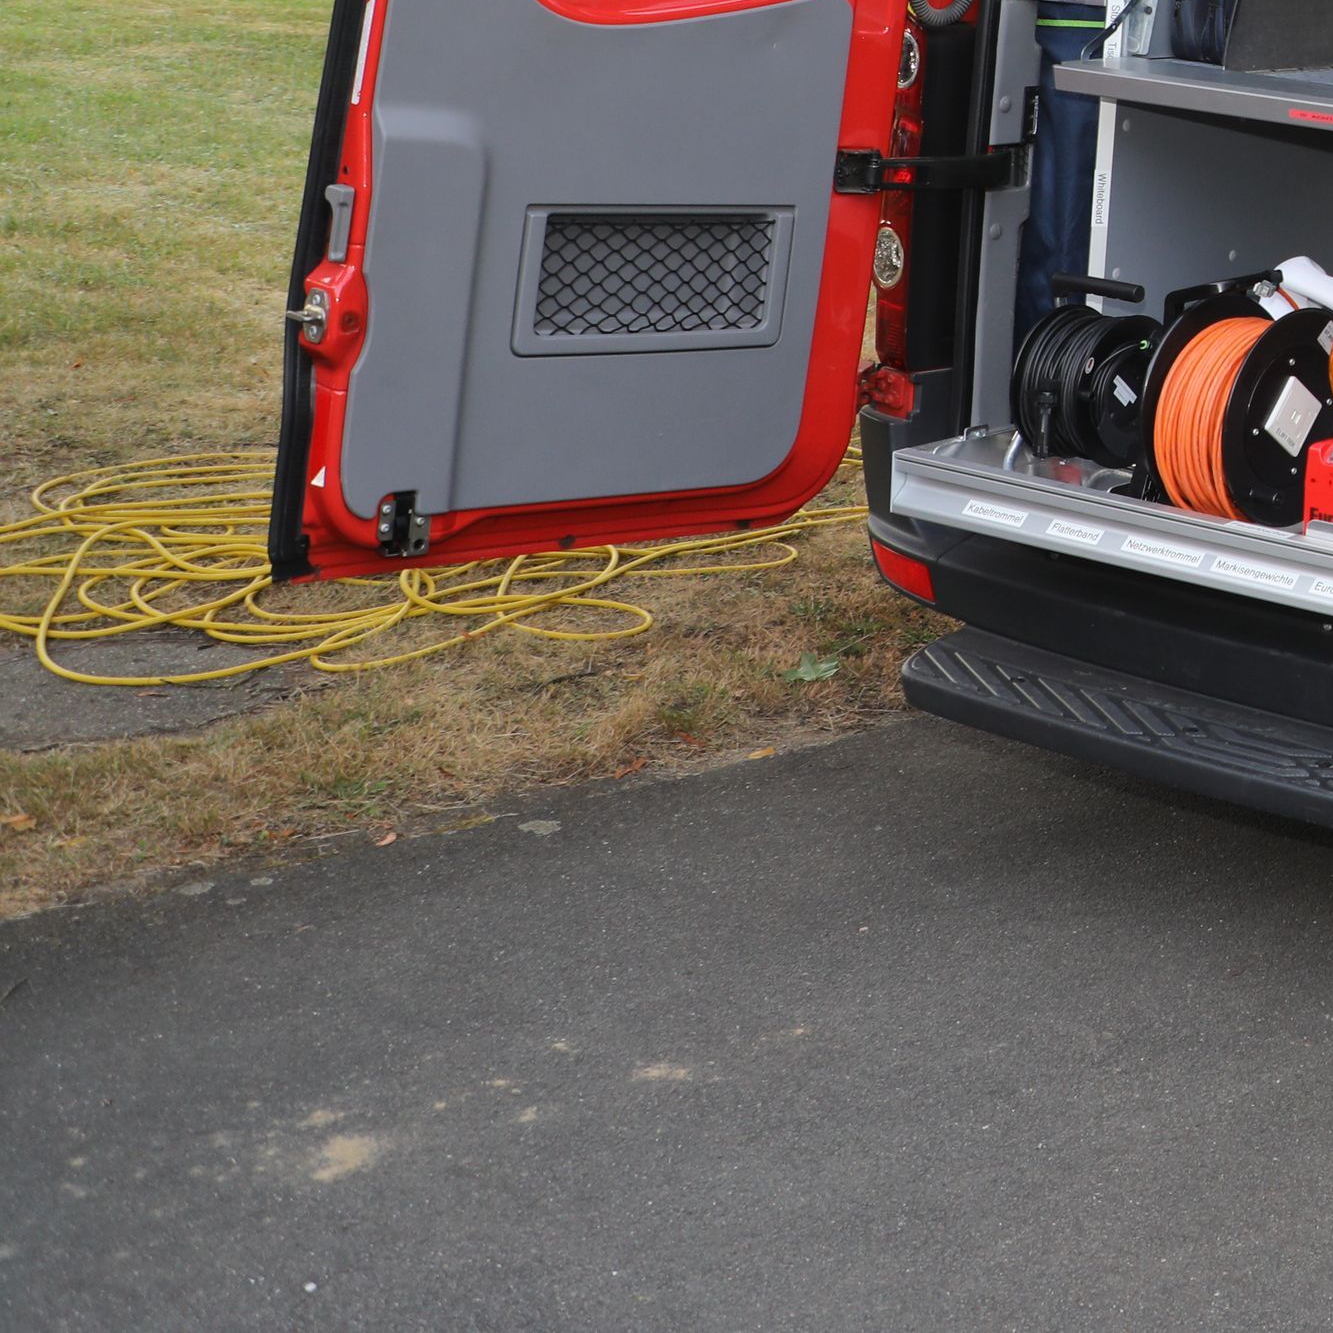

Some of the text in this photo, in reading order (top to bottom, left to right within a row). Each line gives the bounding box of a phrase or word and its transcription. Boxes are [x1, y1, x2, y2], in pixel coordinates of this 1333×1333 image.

[1095, 172, 1108, 225] Whiteboard
[967, 503, 1024, 523] Kabeltrommel
[1051, 521, 1100, 542] Flatterband
[1126, 539, 1201, 564] Netzwerktrommel
[1215, 559, 1295, 587] Markisengewichte
